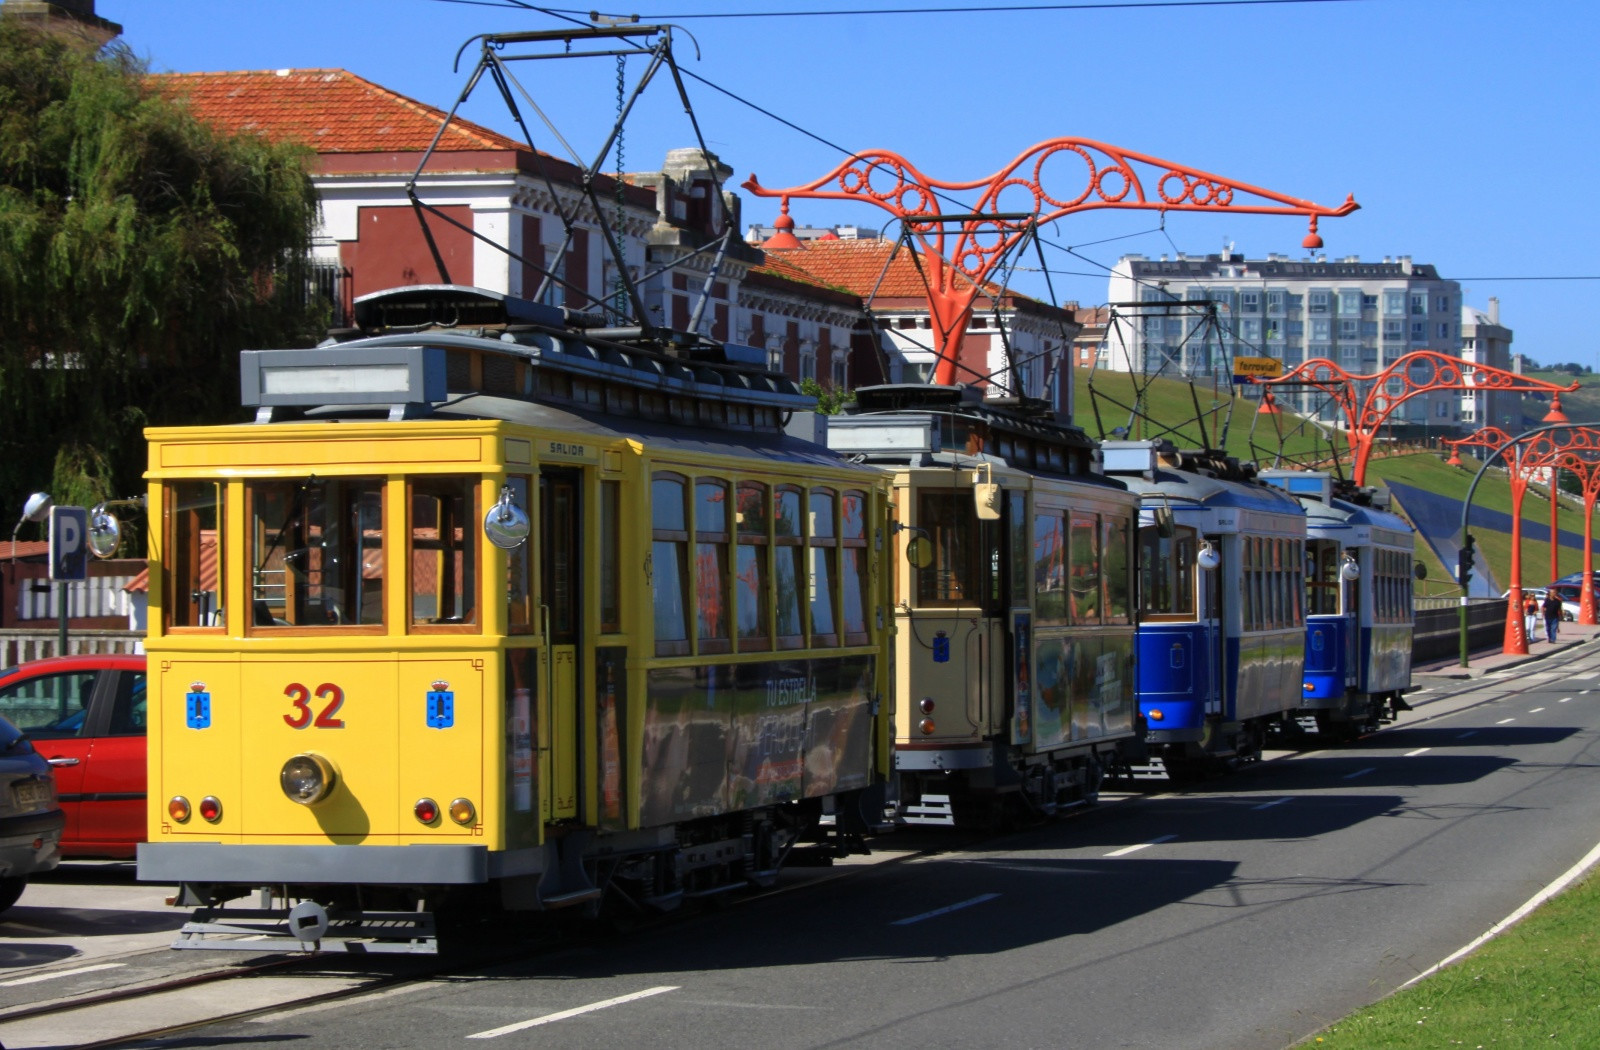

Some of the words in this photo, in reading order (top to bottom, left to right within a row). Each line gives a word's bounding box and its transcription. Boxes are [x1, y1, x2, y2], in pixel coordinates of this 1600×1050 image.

[1239, 361, 1277, 372] ferrovial
[550, 442, 584, 456] SALIDA
[60, 516, 80, 565] P
[283, 683, 345, 730] 32
[766, 679, 777, 707] TU
[778, 676, 817, 706] ESTRELLA
